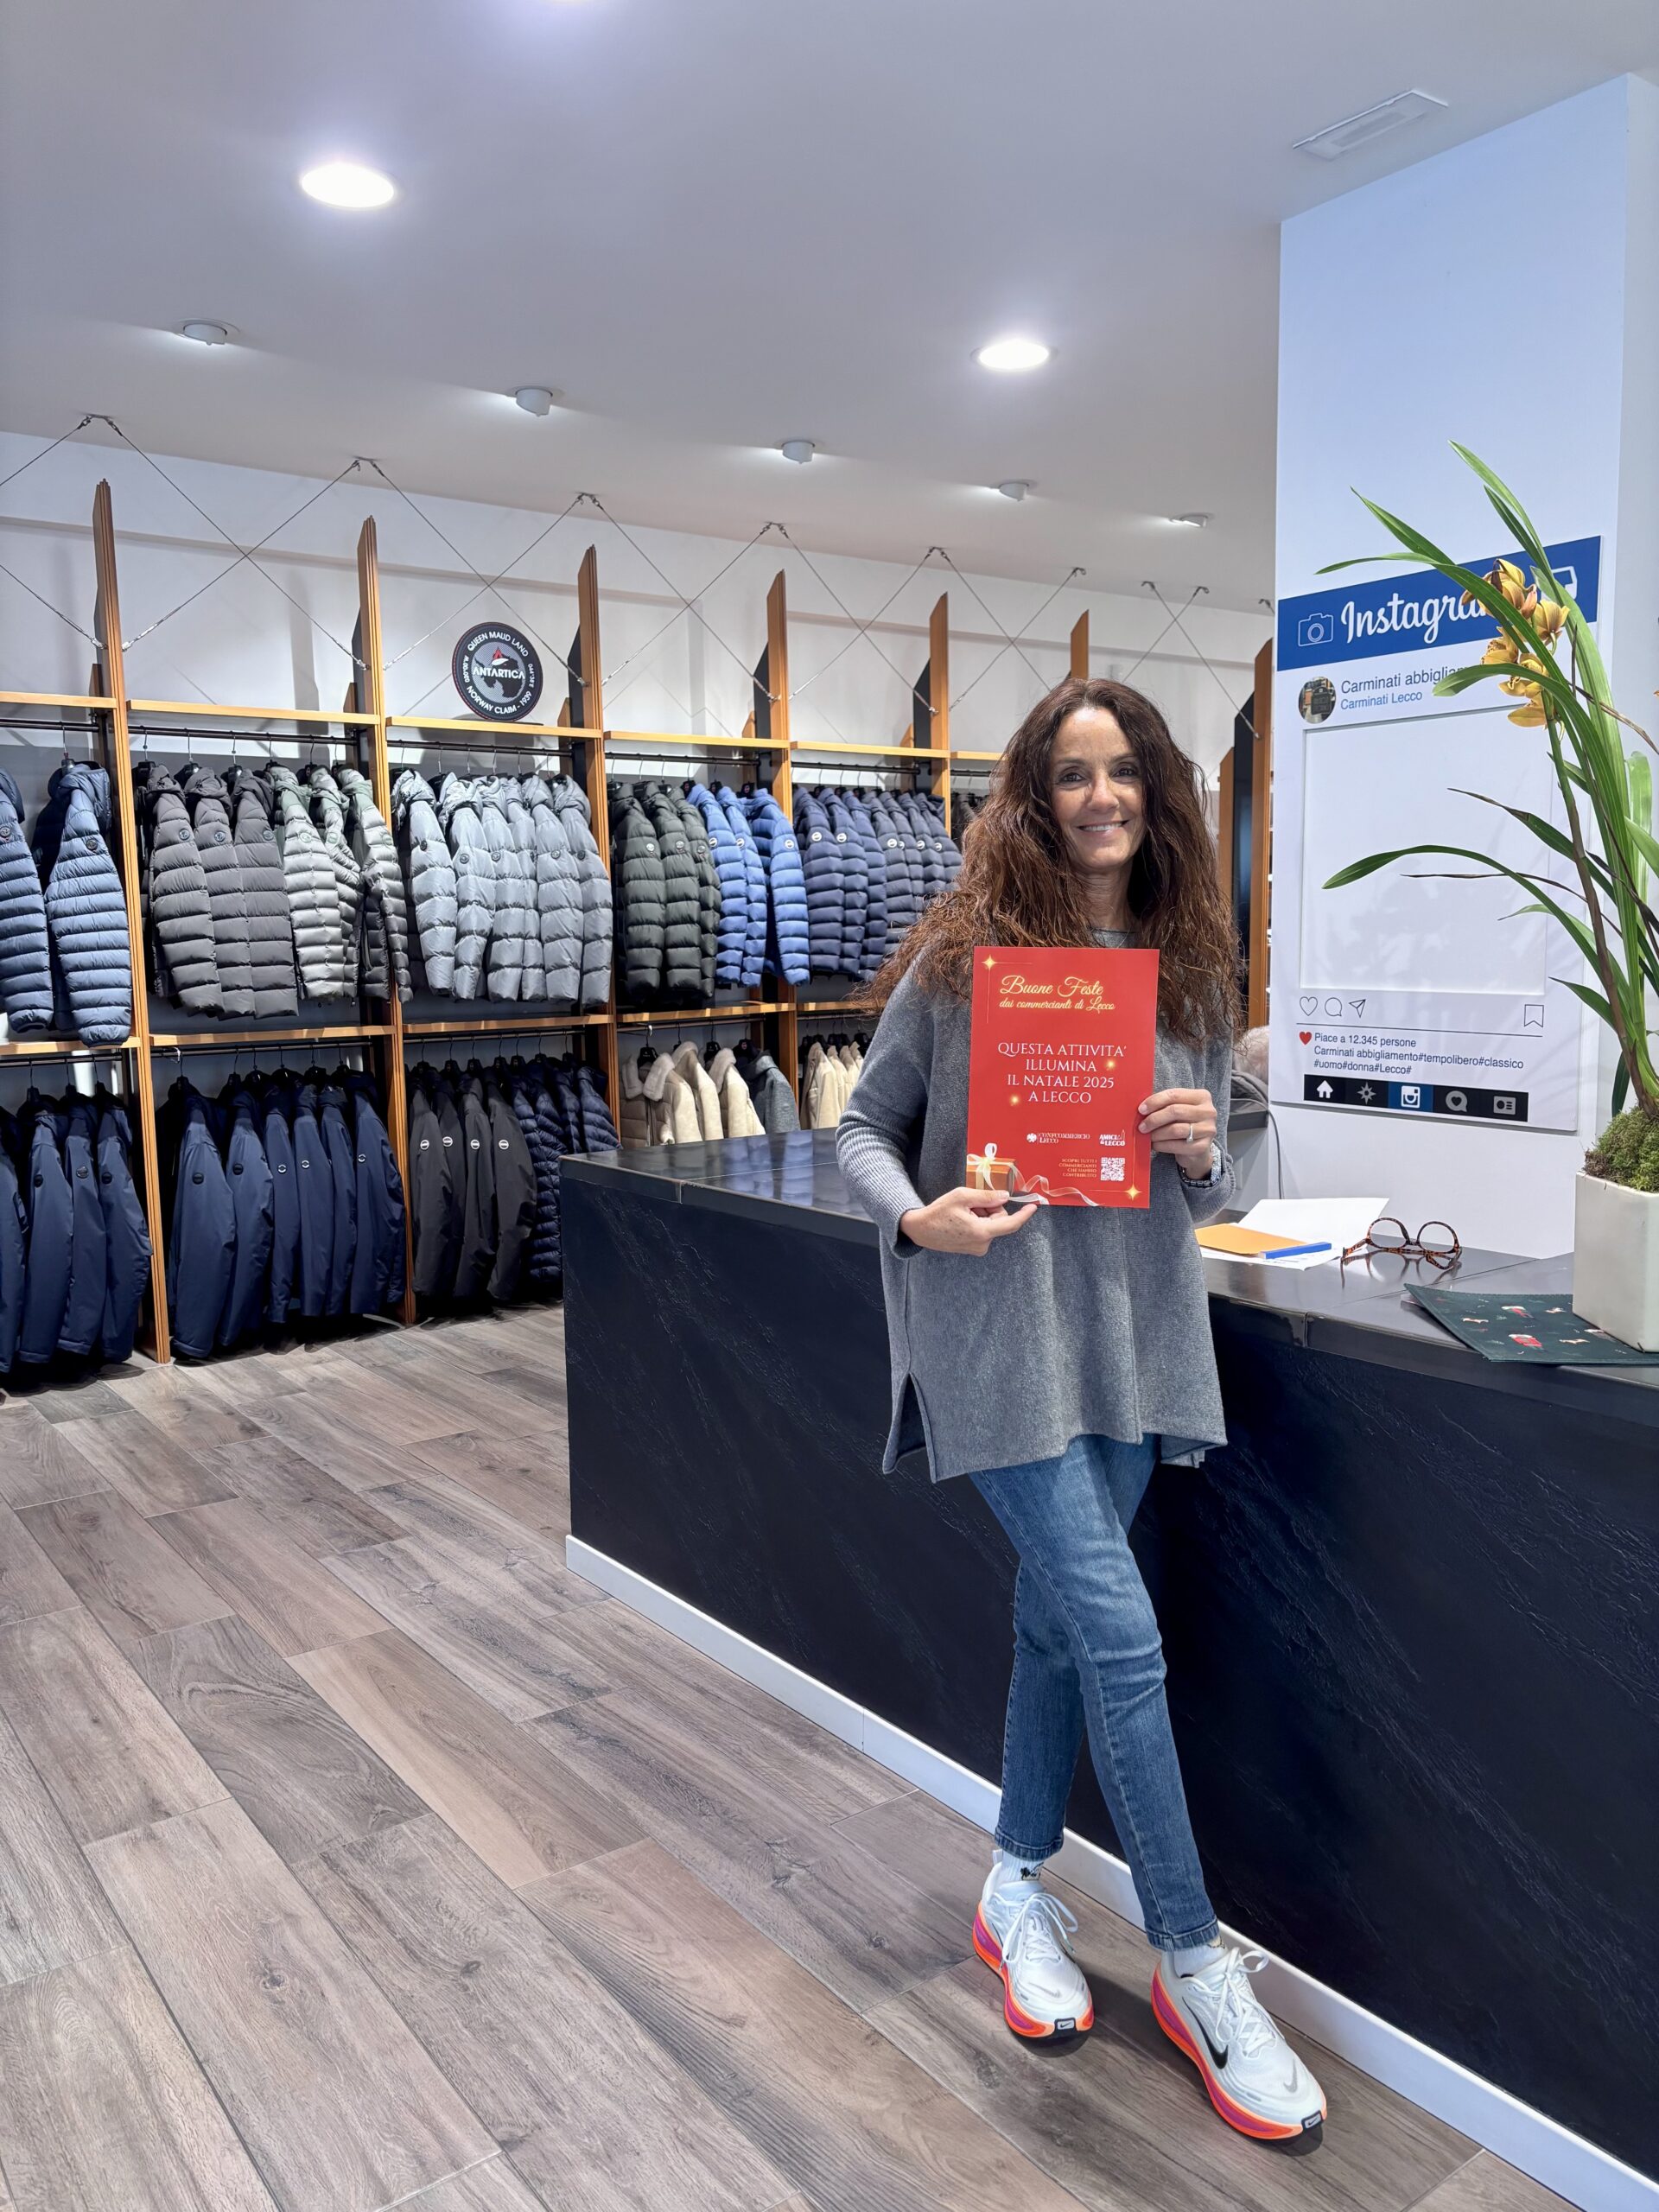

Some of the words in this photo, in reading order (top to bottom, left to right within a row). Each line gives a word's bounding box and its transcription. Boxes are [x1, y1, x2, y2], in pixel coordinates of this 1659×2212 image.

[1341, 593, 1486, 644] Instagra
[467, 632, 488, 652] QUEEN
[489, 632, 511, 641] MAUD
[512, 638, 528, 657] LAND
[473, 666, 525, 679] ANTARTICA
[1341, 674, 1402, 694] Carminati
[1405, 666, 1468, 685] abbigli
[467, 686, 493, 712] NORWAY
[494, 706, 517, 715] CLAIM
[520, 691, 531, 706] 1939
[1340, 694, 1389, 710] Carminati
[1391, 690, 1423, 704] Lecco
[1000, 975, 1052, 995] Buone
[1058, 976, 1103, 998] Feste
[999, 998, 1014, 1008] dai
[1016, 999, 1072, 1010] commercianti
[1075, 999, 1084, 1010] di
[1086, 996, 1116, 1014] Lecco
[998, 1042, 1054, 1056] QUESTA
[1058, 1045, 1127, 1057] ATTIVITA'
[1314, 1033, 1338, 1045] Piace
[1348, 1034, 1377, 1046] 12.345
[1380, 1036, 1416, 1049] persone
[1026, 1059, 1096, 1072] ILLUMINA
[1314, 1046, 1354, 1058] Carminati
[1357, 1048, 1524, 1069] abbigliamento#tempolibero#classico
[1314, 1058, 1412, 1075] #uomo#donna#Lecco#
[1007, 1075, 1020, 1085] IL
[1023, 1075, 1079, 1088] NATALE
[1084, 1077, 1115, 1089] 2025
[1029, 1091, 1039, 1103] A
[1043, 1092, 1091, 1104] LECCO
